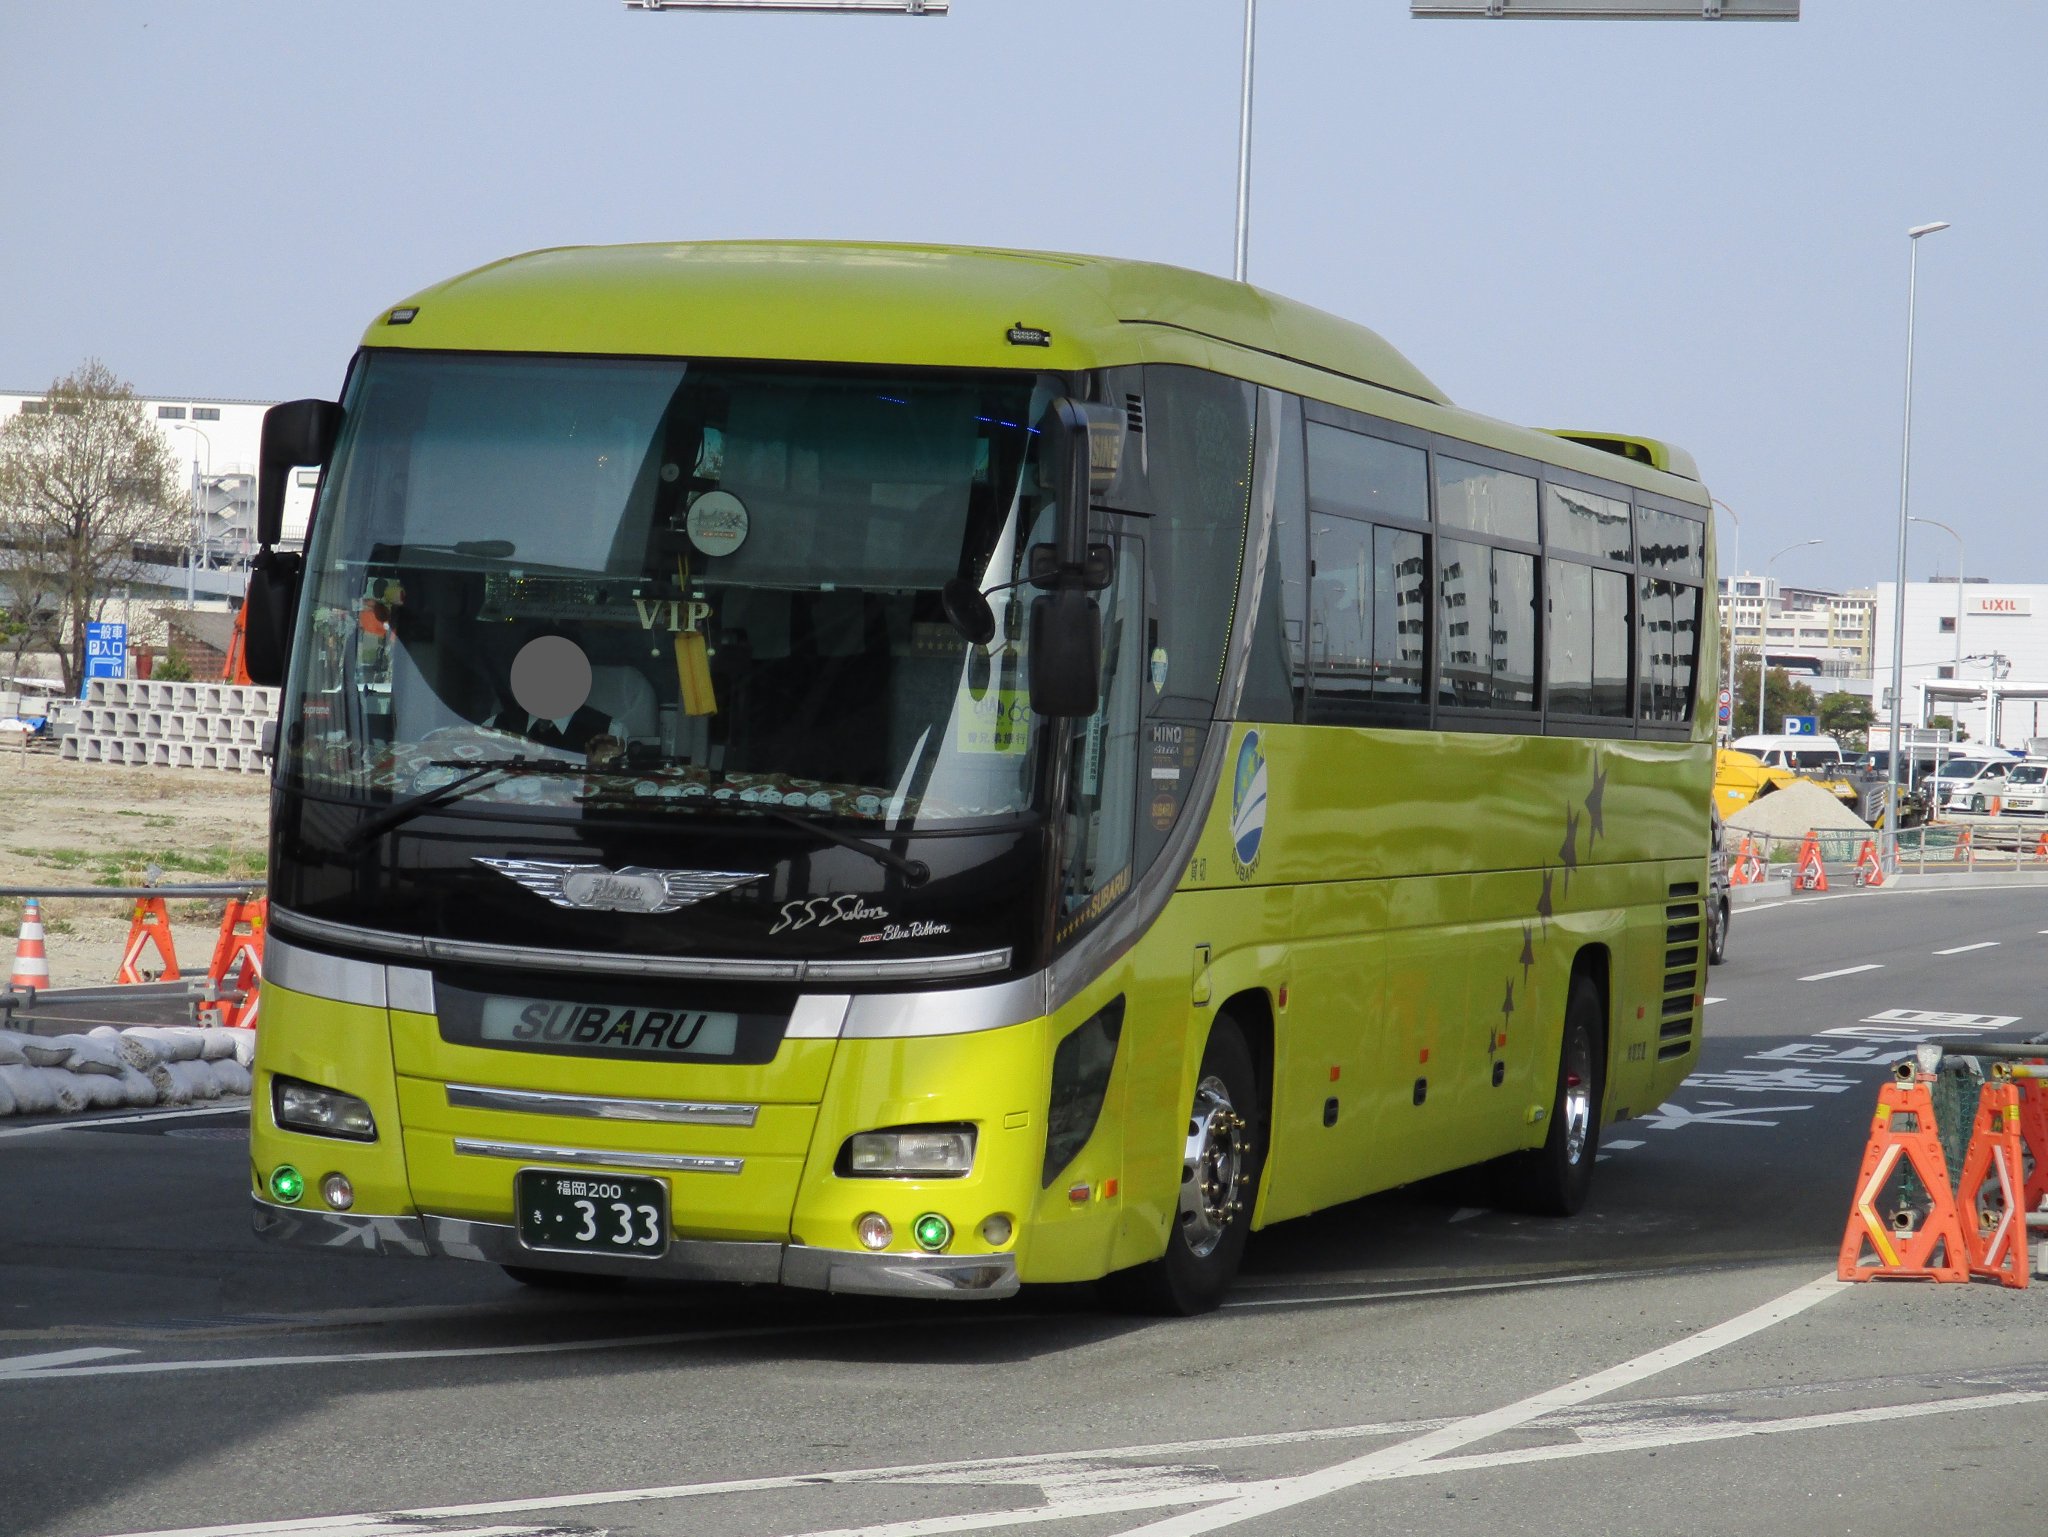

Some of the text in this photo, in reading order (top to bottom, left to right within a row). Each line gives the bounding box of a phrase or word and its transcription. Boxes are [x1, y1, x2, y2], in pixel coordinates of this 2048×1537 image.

[634, 598, 710, 631] VIP
[1982, 599, 2016, 611] LIXIL
[90, 625, 123, 639] 一般車
[112, 665, 121, 677] IN
[1153, 726, 1182, 743] HINO
[1786, 718, 1801, 736] P
[1190, 857, 1207, 881] 貸切
[1231, 847, 1261, 882] SUBARU
[1091, 866, 1131, 918] SUBARU
[819, 894, 889, 927] Salon
[860, 920, 951, 943] HINO Blue Ribbon
[511, 1003, 707, 1049] SUBARU
[533, 1209, 542, 1224] き
